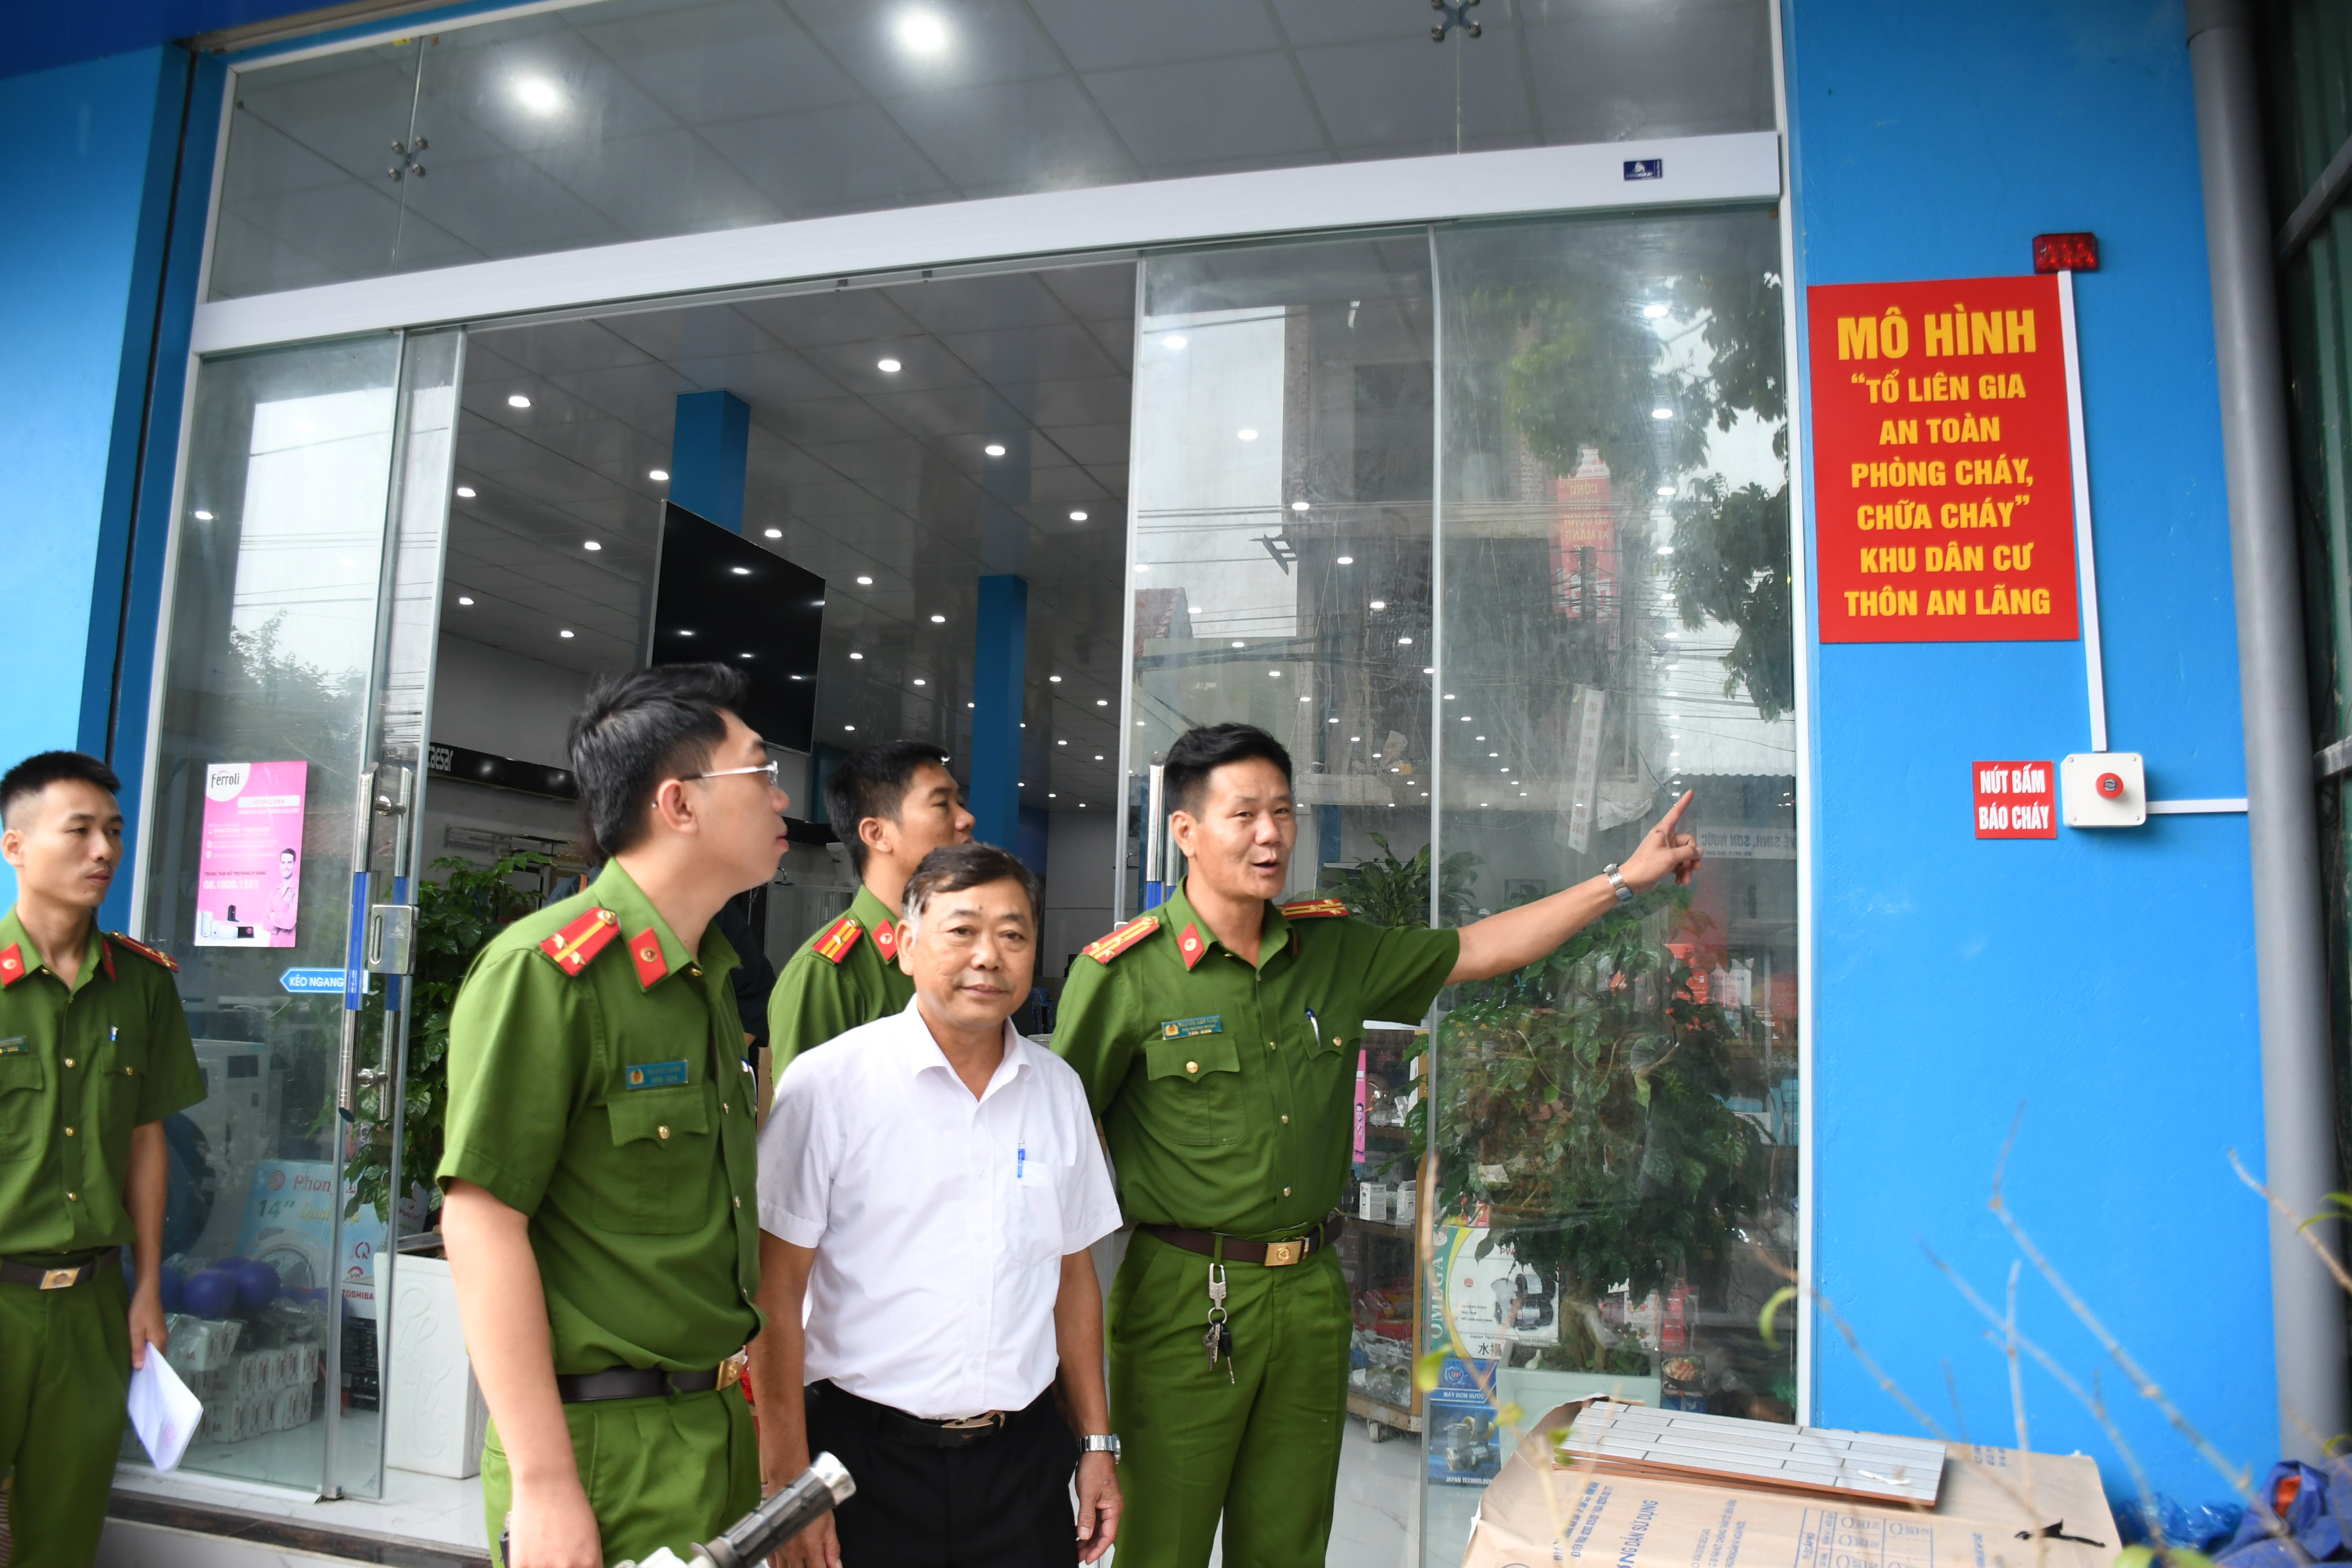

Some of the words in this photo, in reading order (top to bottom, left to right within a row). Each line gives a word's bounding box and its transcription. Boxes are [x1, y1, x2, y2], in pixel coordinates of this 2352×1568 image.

[1838, 307, 1908, 360] MÔ
[1925, 304, 2035, 356] HÌNH
[1908, 372, 1969, 402] LIÊN
[1979, 374, 2025, 399] GIA
[1879, 420, 1918, 444] AN
[1926, 413, 1999, 443] TOÀN
[1851, 456, 1946, 488] PHÒNG
[1955, 454, 2033, 486] CHÁY,
[1857, 500, 1932, 530] CHỮA
[1861, 547, 1916, 573] KHU
[1925, 541, 1984, 572] DÂN
[1993, 542, 2034, 571] CƯ
[1844, 586, 1917, 616] THÔN
[1927, 590, 1966, 615] AN
[1976, 584, 2050, 614] LÃNG
[1980, 766, 2008, 793] NÚT
[2012, 764, 2045, 793] BẤM
[1979, 803, 2008, 829] BÁO
[2012, 802, 2048, 829] CHÁY
[204, 879, 259, 890] 08.1800.1501
[289, 974, 308, 987] KÉO
[310, 977, 345, 987] NGANG
[341, 1289, 375, 1300] TOSHIBA
[1431, 1256, 1444, 1339] OMEGA
